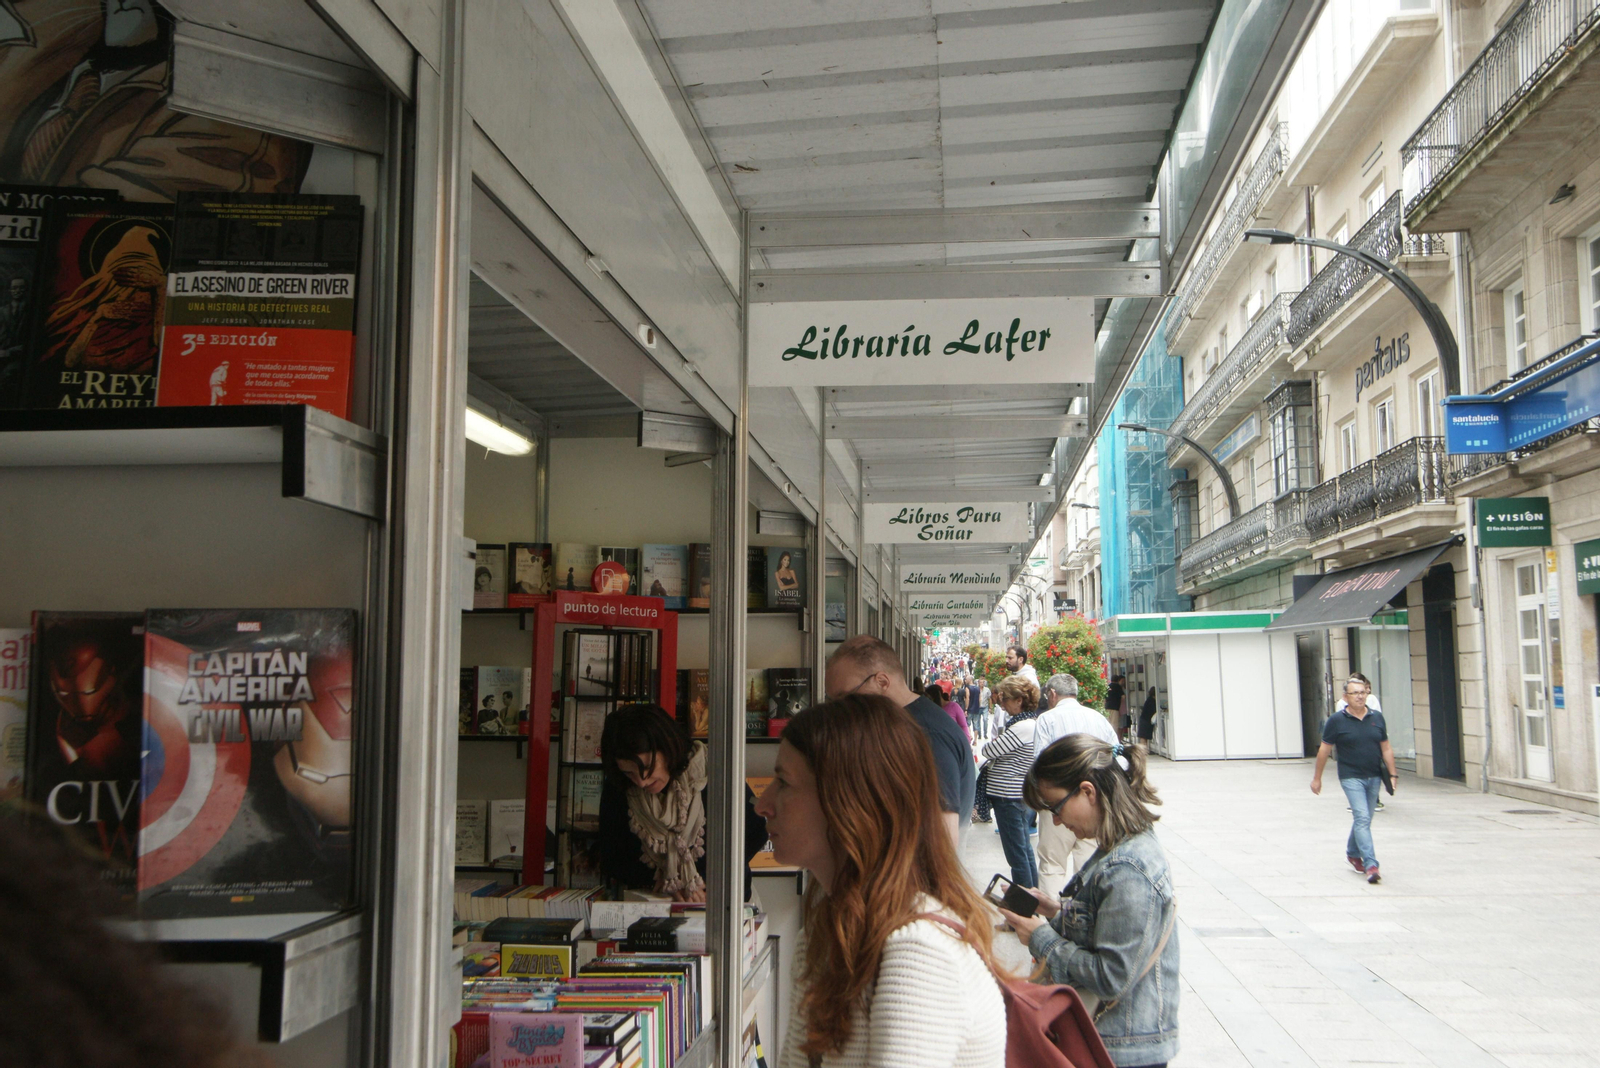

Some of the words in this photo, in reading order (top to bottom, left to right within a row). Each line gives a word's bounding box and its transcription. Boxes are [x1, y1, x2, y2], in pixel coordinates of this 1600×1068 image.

[175, 276, 189, 293] EL
[191, 276, 246, 293] ASESINO
[248, 277, 264, 293] DE
[266, 277, 307, 294] GREEN
[310, 278, 349, 295] RIVER
[188, 302, 205, 311] UNA
[207, 303, 246, 312] HISTORIA
[248, 303, 258, 312] DE
[260, 304, 309, 313] DETECTIVES
[311, 304, 331, 314] REAL
[209, 332, 278, 346] EDICIÓN
[782, 324, 931, 362] Libraría
[942, 317, 1052, 362] Lafer
[256, 362, 282, 370] matado
[308, 364, 335, 373] mujeres
[59, 371, 83, 384] EL
[81, 370, 152, 396] REY
[294, 372, 330, 380] acordarme
[1452, 414, 1499, 423] santalucía
[888, 507, 950, 525] Libros
[956, 506, 1002, 523] Para
[1498, 511, 1544, 522] VISIÓN
[917, 524, 974, 541] Soñar
[903, 572, 946, 584] Libraría
[949, 572, 1001, 584] Mendinho
[1319, 568, 1400, 600] FLORENTINO
[1578, 572, 1583, 582] El
[774, 589, 801, 598] ISABEL
[564, 602, 600, 614] punto
[601, 602, 616, 615] de
[620, 604, 658, 618] lectura
[909, 600, 944, 610] Libraría
[946, 599, 984, 610] Cartabón
[238, 622, 261, 632] MARVEL
[188, 648, 308, 676] CAPITÁN
[178, 673, 314, 704] AMÉRICA
[188, 708, 246, 744] CIVIL
[249, 708, 304, 742] WAR
